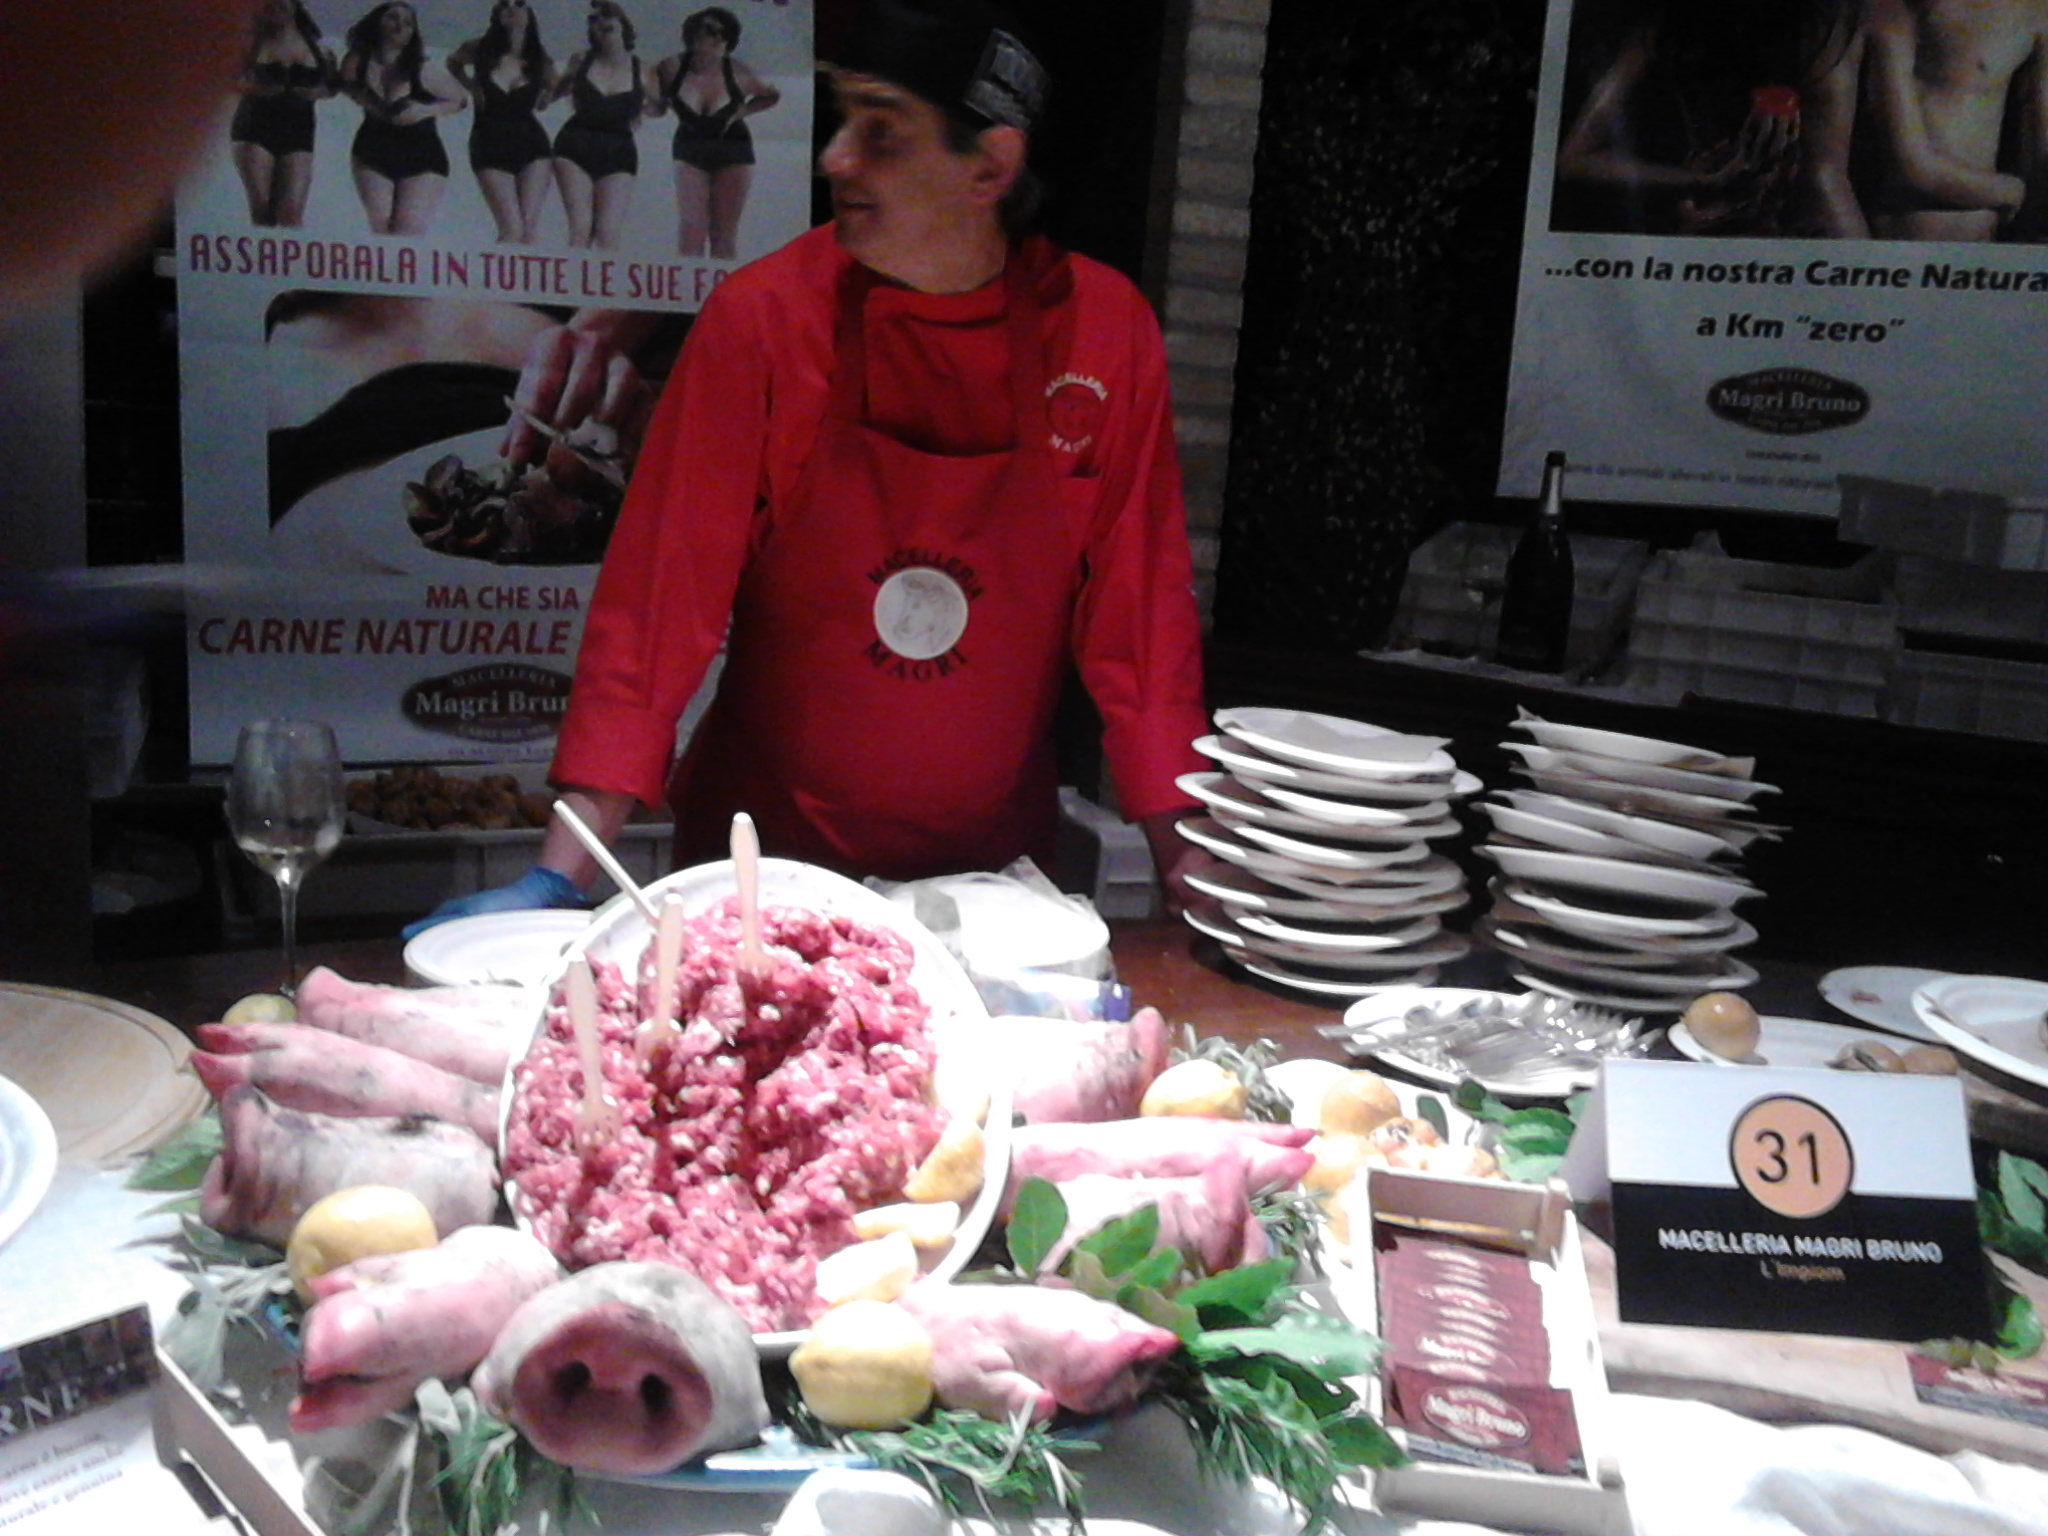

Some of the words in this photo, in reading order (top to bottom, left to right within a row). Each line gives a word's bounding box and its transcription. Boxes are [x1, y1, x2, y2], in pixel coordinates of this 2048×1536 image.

[189, 233, 417, 285] ASSAPORALA
[431, 249, 469, 288] IN
[480, 252, 569, 295] TUTTE
[580, 259, 616, 297] LE
[627, 263, 682, 301] SUE
[1643, 256, 1674, 281] la
[1682, 259, 1795, 286] nostra
[1804, 259, 1911, 289] Carne
[1919, 263, 2048, 293] Natura
[1696, 315, 1718, 337] a
[1725, 312, 1785, 339] Km
[426, 585, 470, 610] MA
[476, 585, 531, 611] CHE
[537, 586, 581, 611] SIA
[197, 616, 347, 656] CARNE
[355, 617, 574, 656] NATURALE
[414, 690, 500, 721] Magri
[1754, 1129, 1821, 1186] 31
[1657, 1227, 1793, 1257] MACELLERIA
[1865, 1238, 1944, 1264] BRUNO
